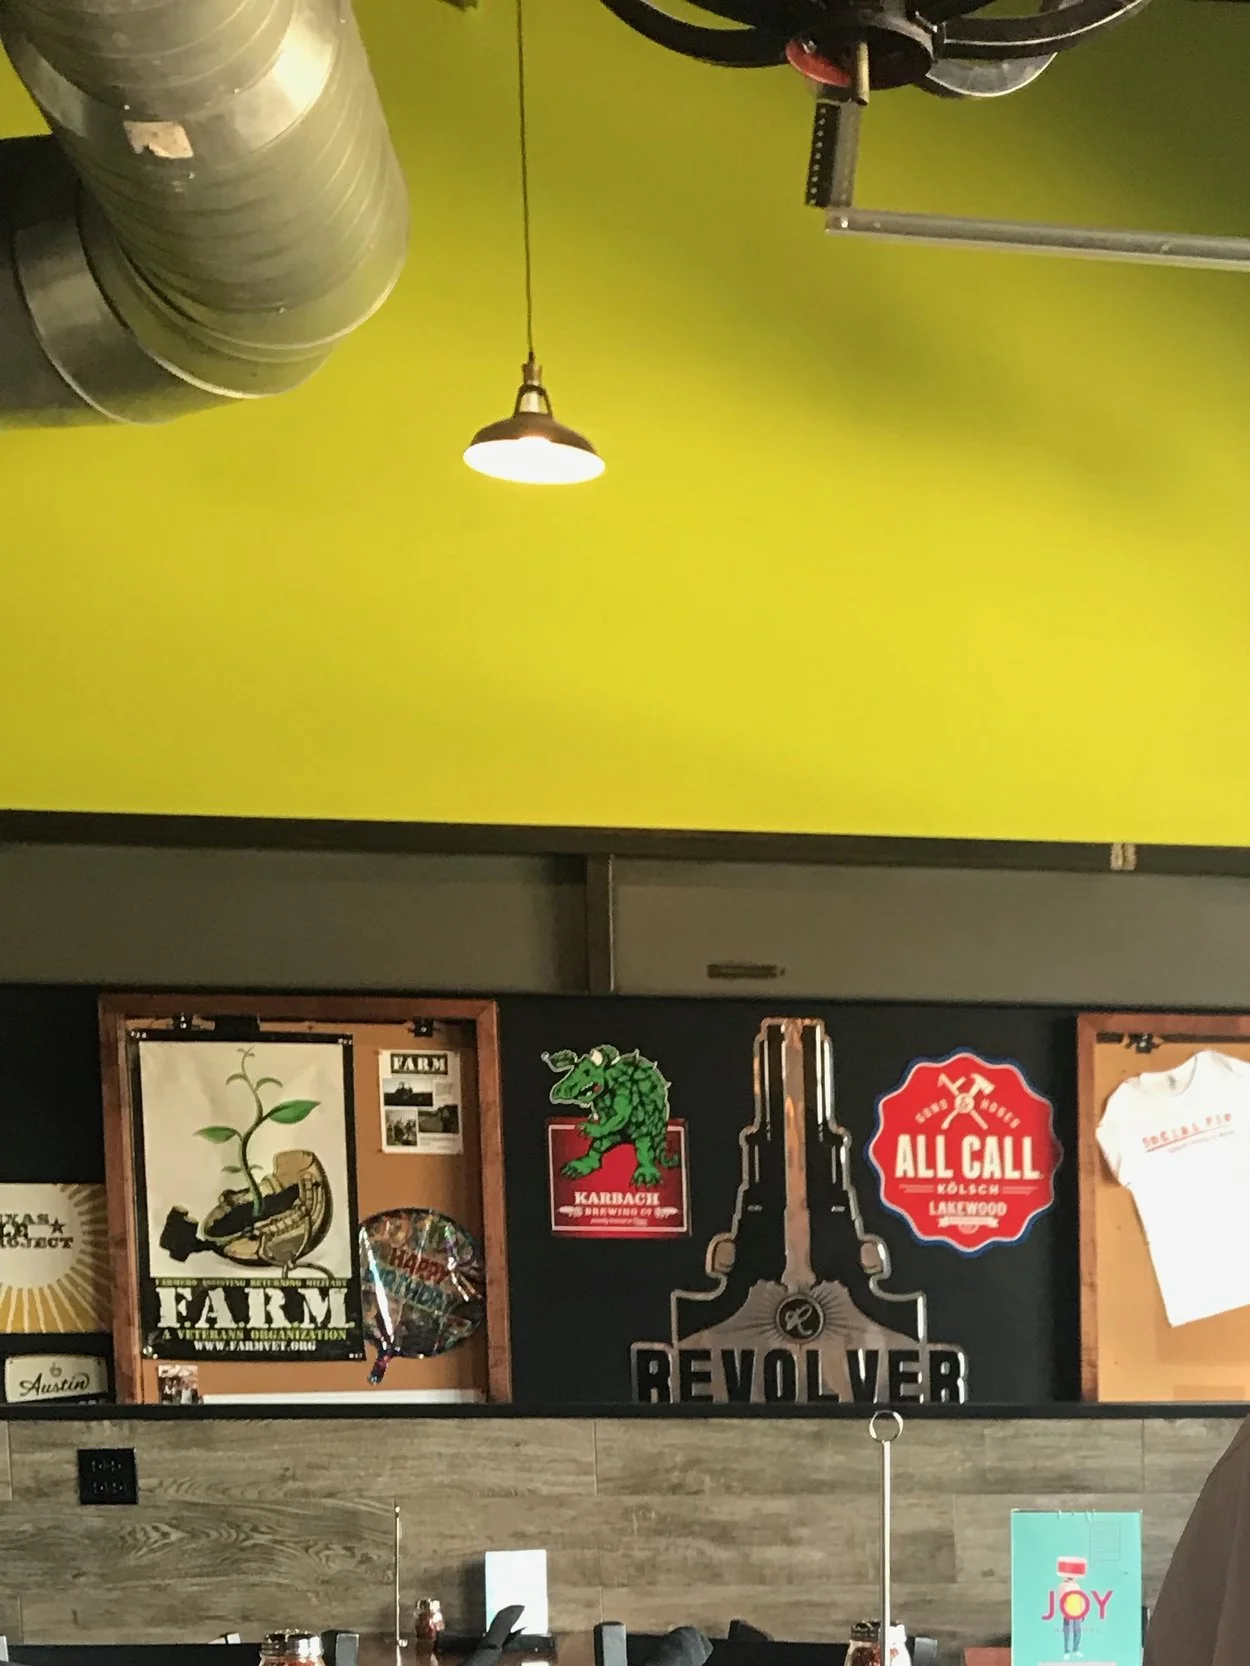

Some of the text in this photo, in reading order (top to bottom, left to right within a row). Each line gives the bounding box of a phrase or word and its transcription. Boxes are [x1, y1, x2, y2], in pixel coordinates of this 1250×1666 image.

[392, 1056, 446, 1071] FARM
[895, 1134, 1043, 1180] ALL CALL
[936, 1181, 1000, 1195] KÖLSCH
[574, 1191, 661, 1206] KARBACH
[584, 1207, 638, 1216] BREWING
[929, 1201, 1008, 1217] LAKEWOOD
[155, 1286, 356, 1329] F.A.R.M.
[163, 1329, 347, 1341] A VETERANS ORGANIZATION
[193, 1340, 317, 1351] WWW.FARMVET.ORG
[634, 1347, 966, 1403] REVOLVER
[19, 1372, 90, 1397] Austin
[1041, 1589, 1113, 1621] JOY
